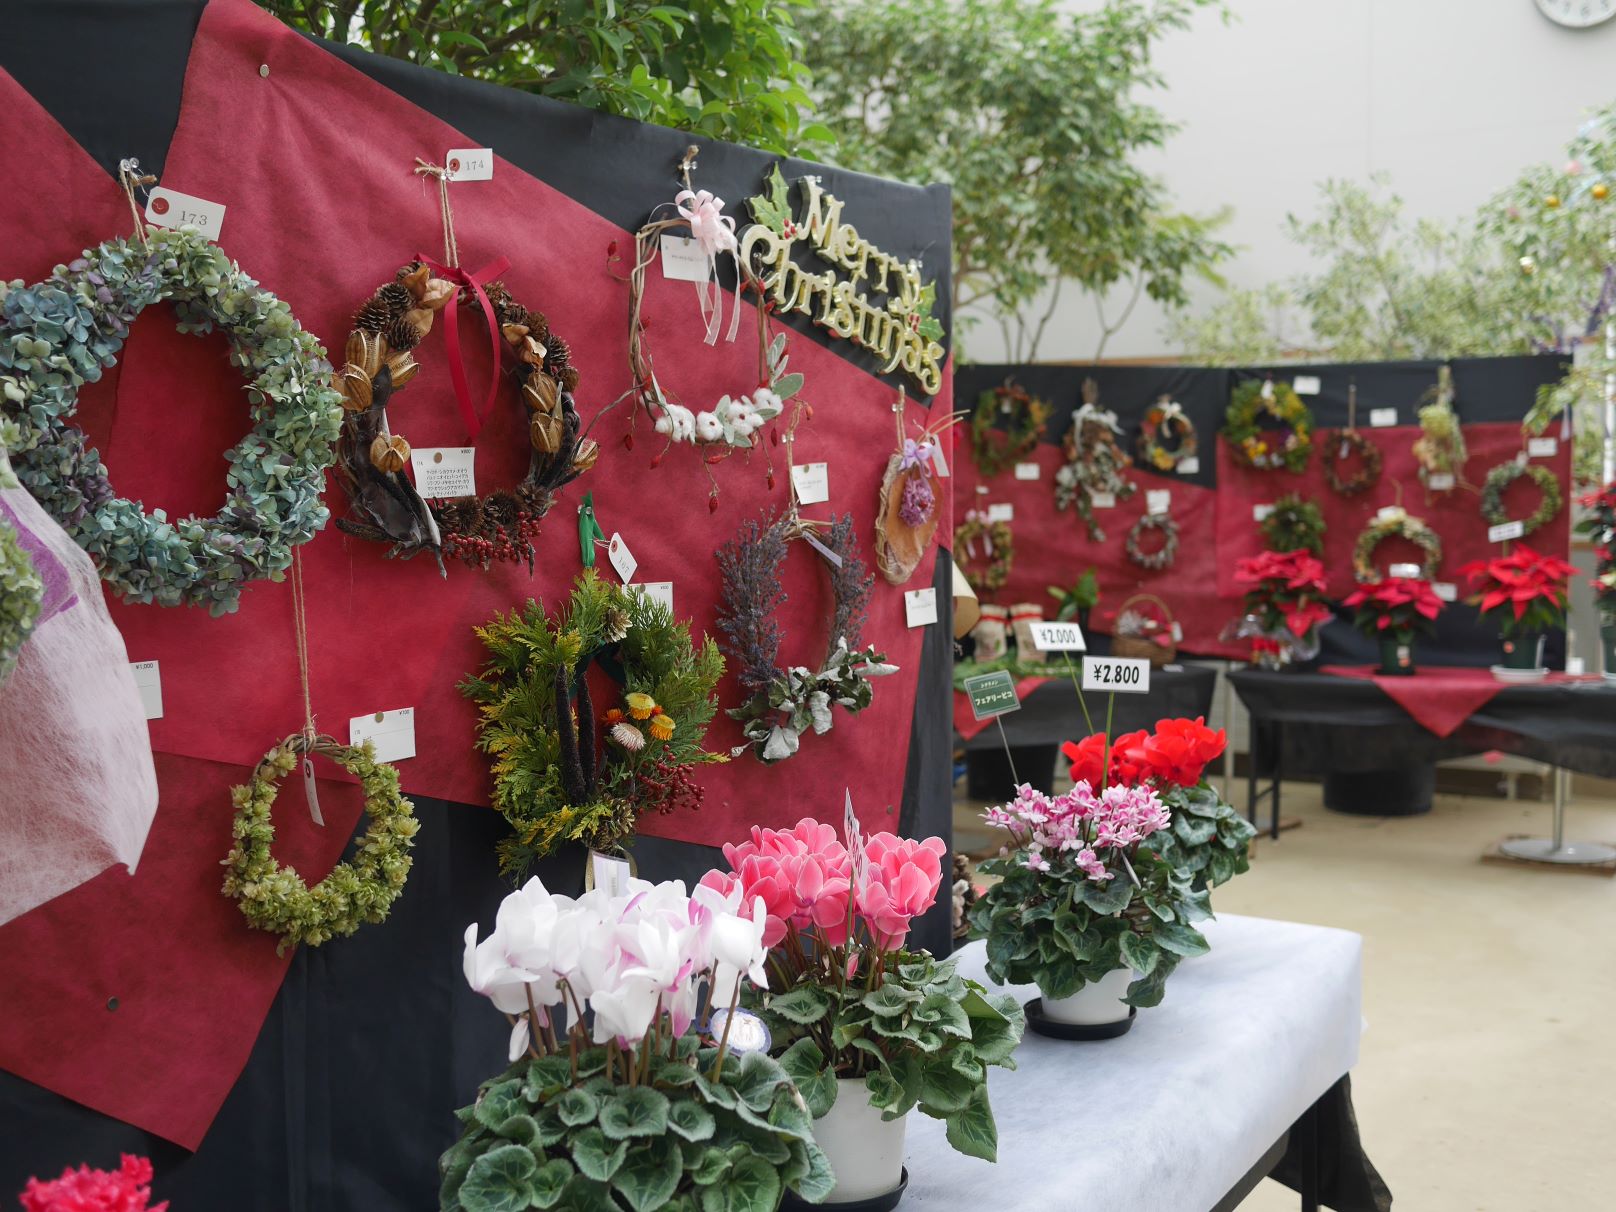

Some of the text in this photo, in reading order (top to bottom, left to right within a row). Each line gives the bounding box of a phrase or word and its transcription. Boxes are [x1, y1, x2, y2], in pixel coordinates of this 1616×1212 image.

[465, 160, 484, 171] 174
[180, 210, 208, 226] 173
[797, 175, 922, 315] Merry
[738, 224, 945, 396] Christmas
[1093, 664, 1140, 684] ¥2,800
